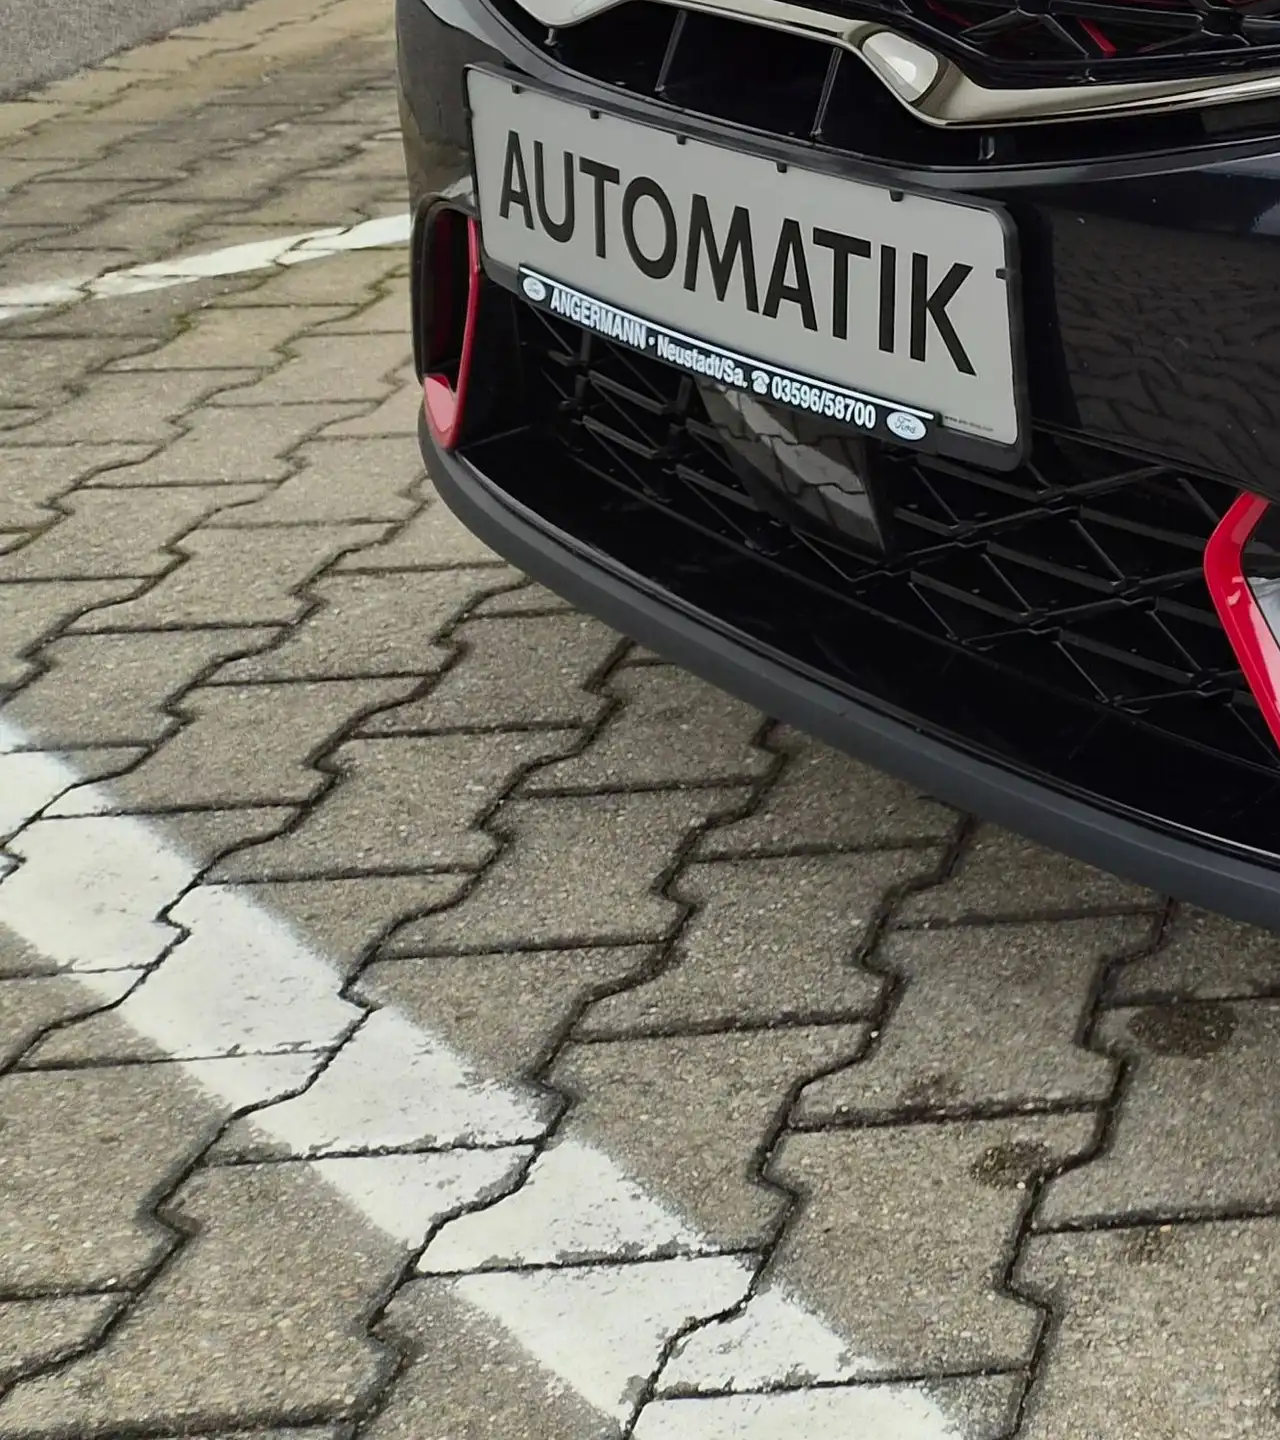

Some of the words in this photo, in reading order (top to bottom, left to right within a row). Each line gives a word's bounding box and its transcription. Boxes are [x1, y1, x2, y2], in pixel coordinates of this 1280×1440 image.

[498, 129, 978, 378] AUTOMATIK
[550, 286, 647, 350] ANGERMANN
[656, 334, 749, 388] Neustadt/Sa.
[771, 375, 877, 430] 03596/58700
